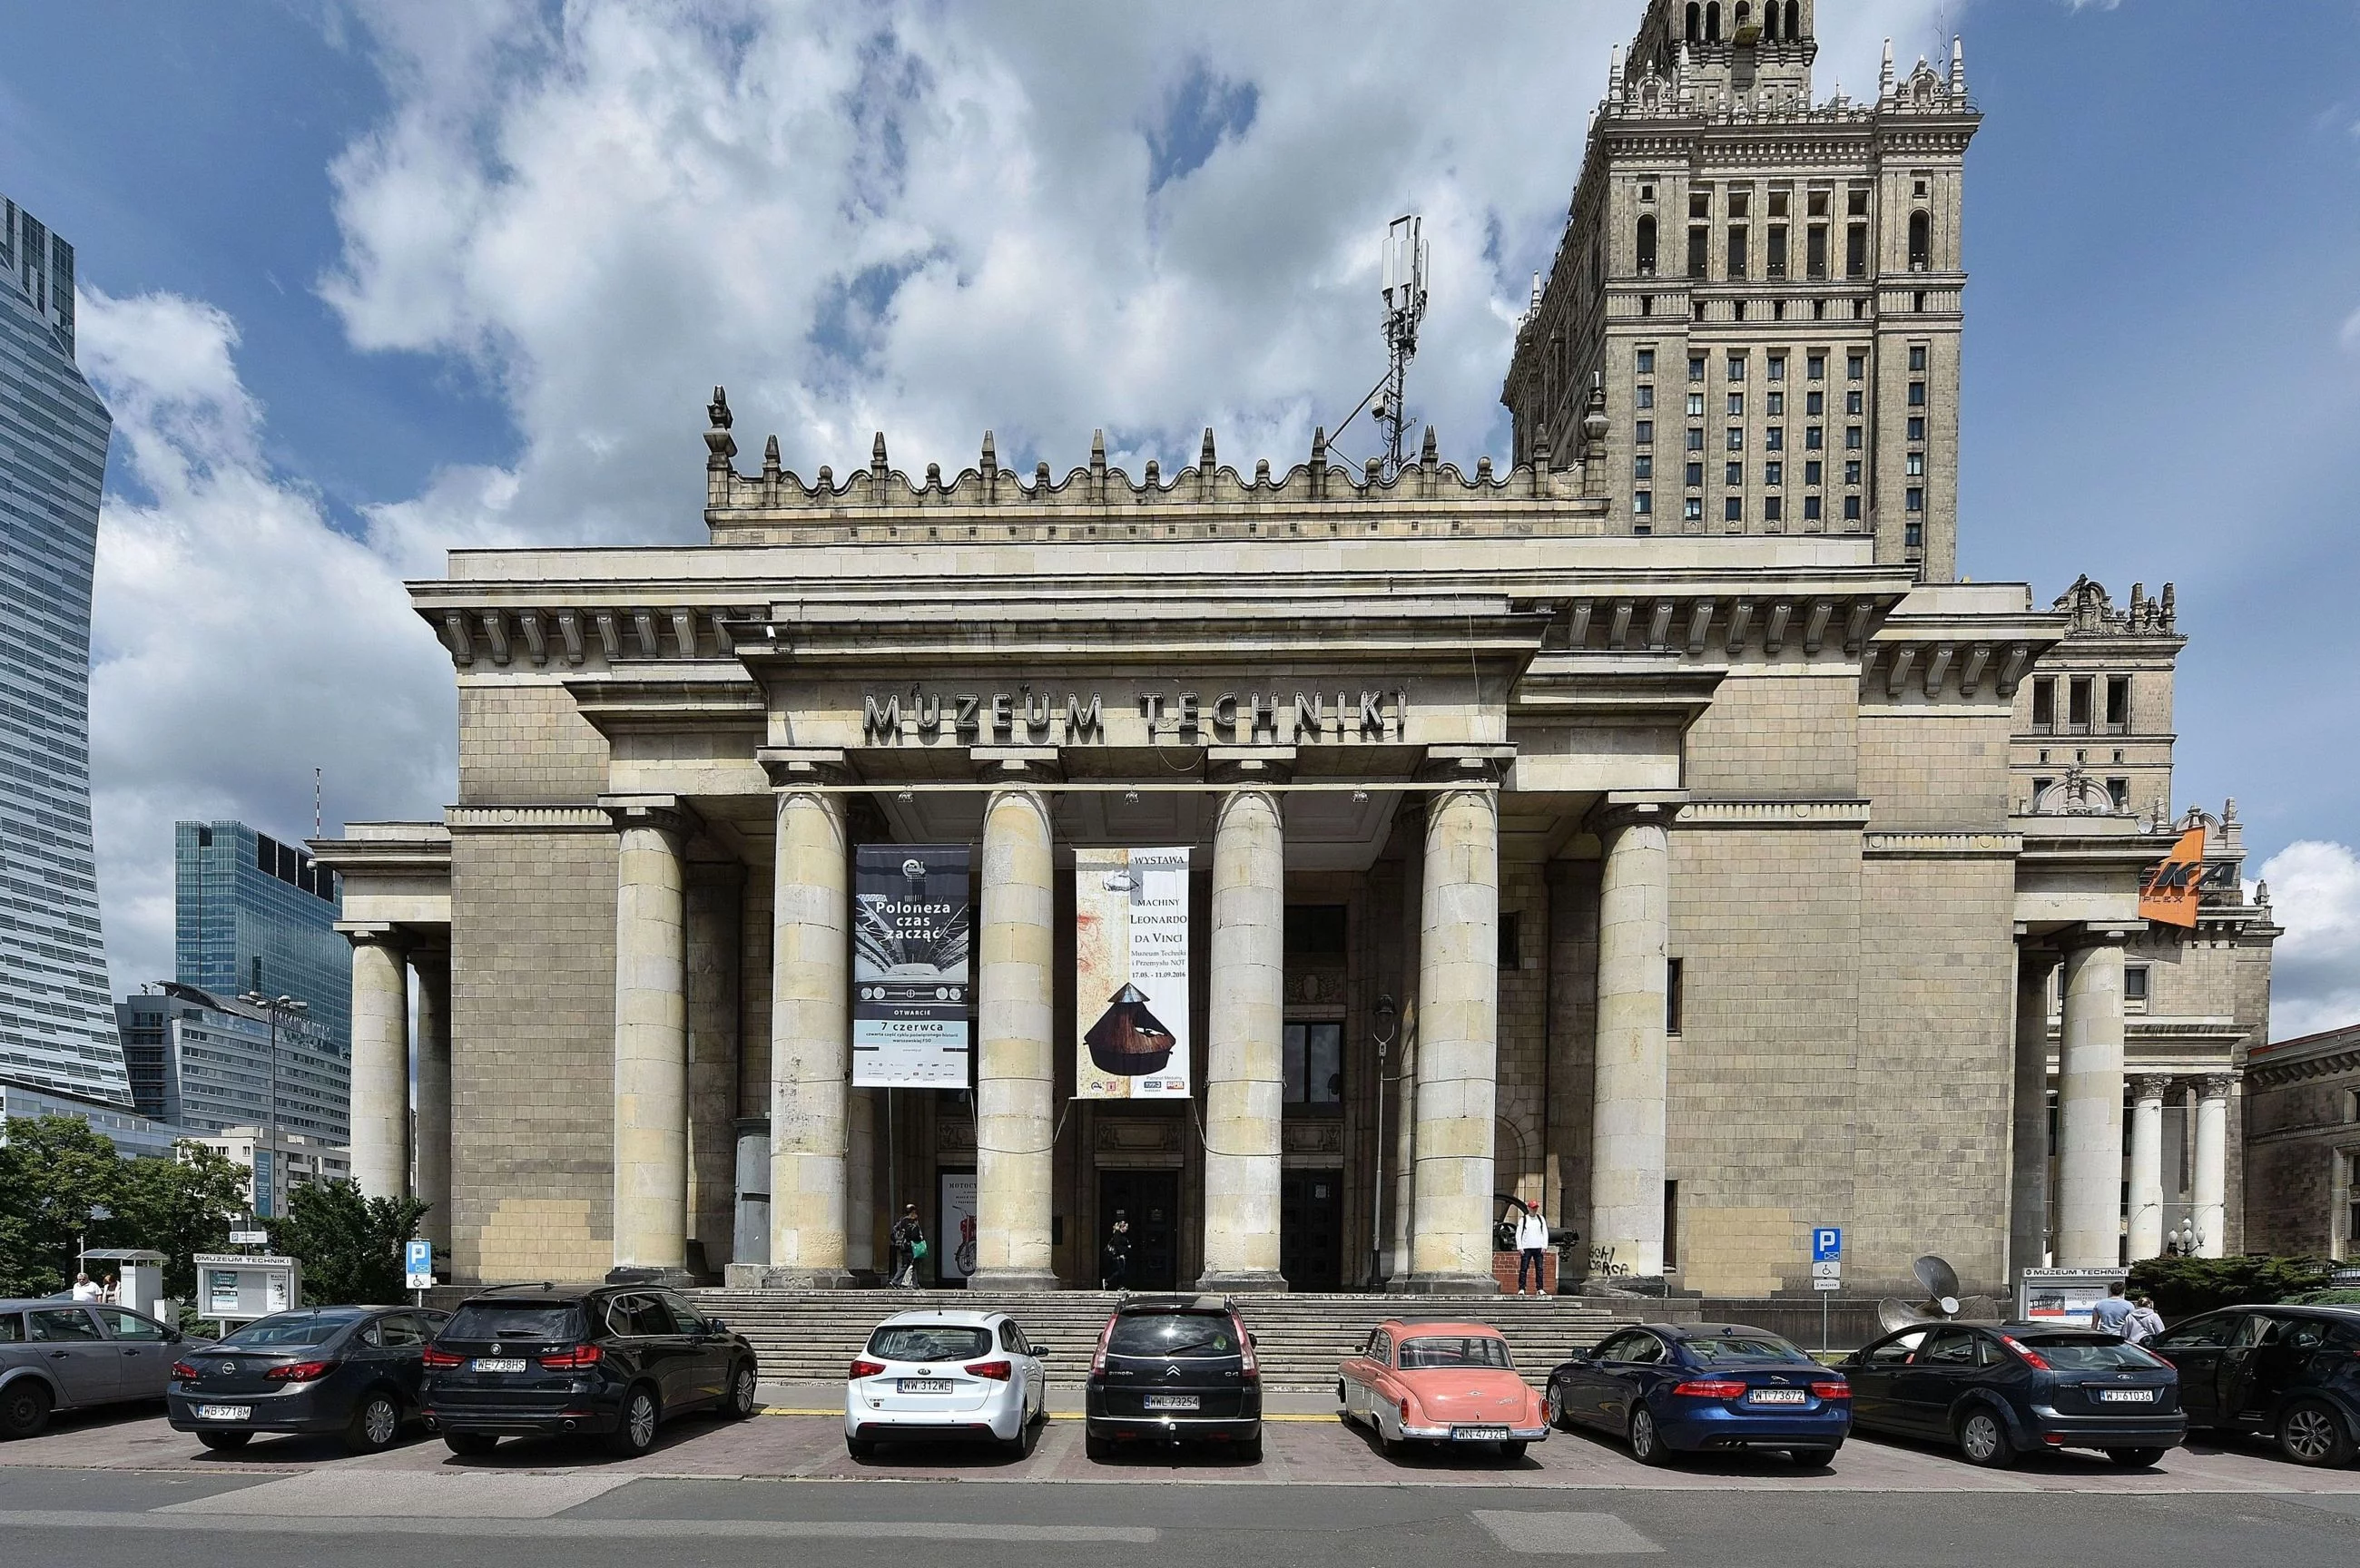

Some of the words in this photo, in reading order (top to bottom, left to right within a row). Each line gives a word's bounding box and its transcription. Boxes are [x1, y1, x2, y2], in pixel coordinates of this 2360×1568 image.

[862, 691, 1105, 730] MUZEUM
[1139, 690, 1407, 729] TECHNIKI
[1135, 856, 1185, 864] WYSTAWA
[1137, 898, 1180, 906] MACHINY
[876, 901, 950, 914] Poloneza
[896, 916, 930, 926] czas
[886, 926, 942, 943] zacząć
[1136, 959, 1169, 967] Przemysłu
[880, 1022, 888, 1031] 7
[892, 1024, 944, 1032] czerwca
[1820, 1230, 1835, 1252] P
[411, 1244, 426, 1264] P
[477, 1359, 491, 1369] WE
[495, 1359, 525, 1369] 738HS
[903, 1380, 918, 1390] WW
[920, 1380, 951, 1391] 312WE
[1754, 1390, 1768, 1400] WT
[1773, 1390, 1804, 1400] 73672
[2106, 1391, 2119, 1401] WJ
[2123, 1391, 2151, 1401] 61036
[1150, 1396, 1168, 1406] WWL
[1170, 1396, 1198, 1406] 73254
[203, 1406, 217, 1416] WB
[220, 1406, 250, 1416] 5718M
[1458, 1429, 1472, 1439] WN
[1475, 1429, 1506, 1439] 4732E
